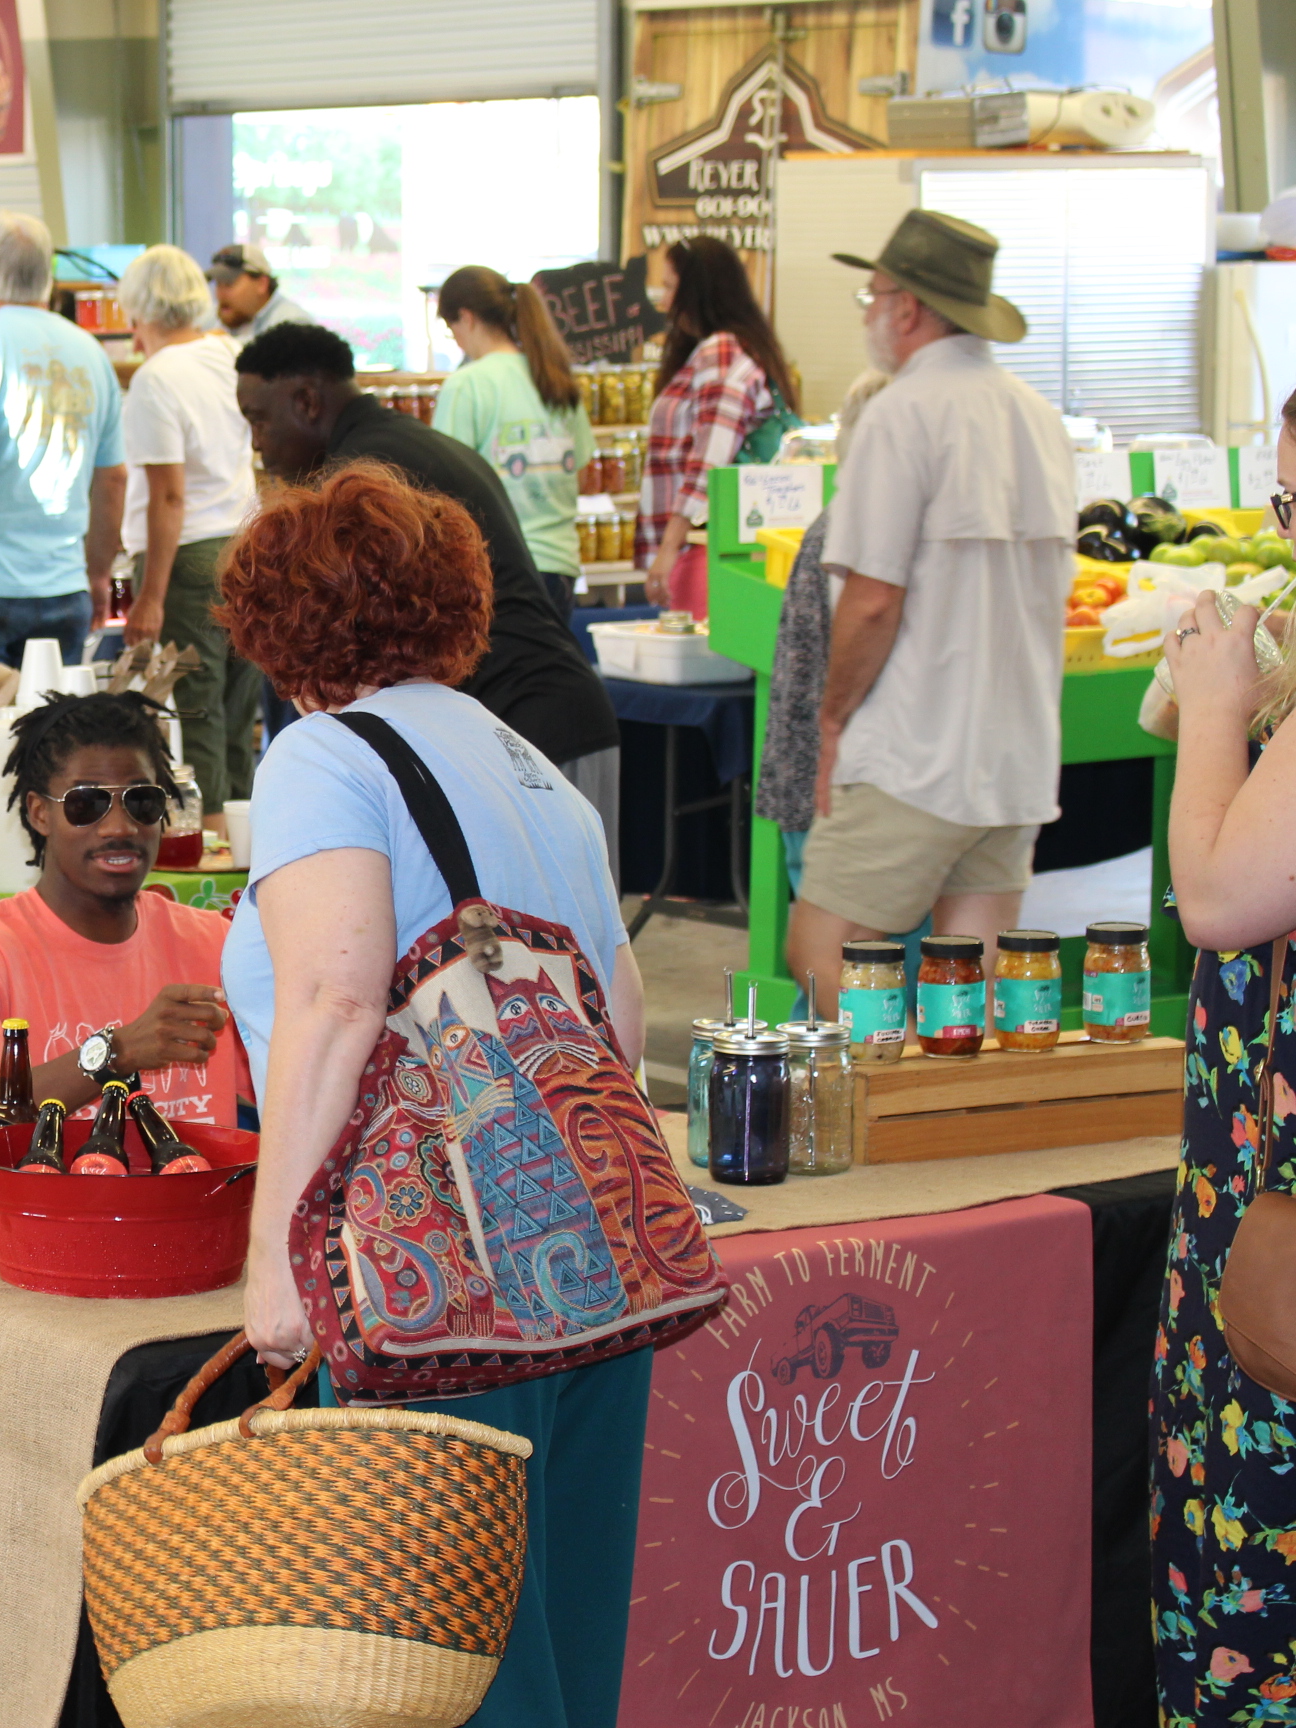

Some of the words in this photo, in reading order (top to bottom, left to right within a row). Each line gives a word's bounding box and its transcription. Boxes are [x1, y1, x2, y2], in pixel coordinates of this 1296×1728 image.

[688, 157, 760, 193] REYER
[544, 273, 624, 338] BEEF
[160, 1095, 213, 1118] CITY
[703, 1266, 773, 1349] FARM
[773, 1247, 811, 1285] TO
[816, 1238, 937, 1298] FERMENT
[707, 1338, 936, 1530] Sweet
[785, 1454, 862, 1562] &
[708, 1538, 939, 1678] SAUER
[735, 1702, 848, 1728] JACKSON
[870, 1676, 908, 1722] MS
